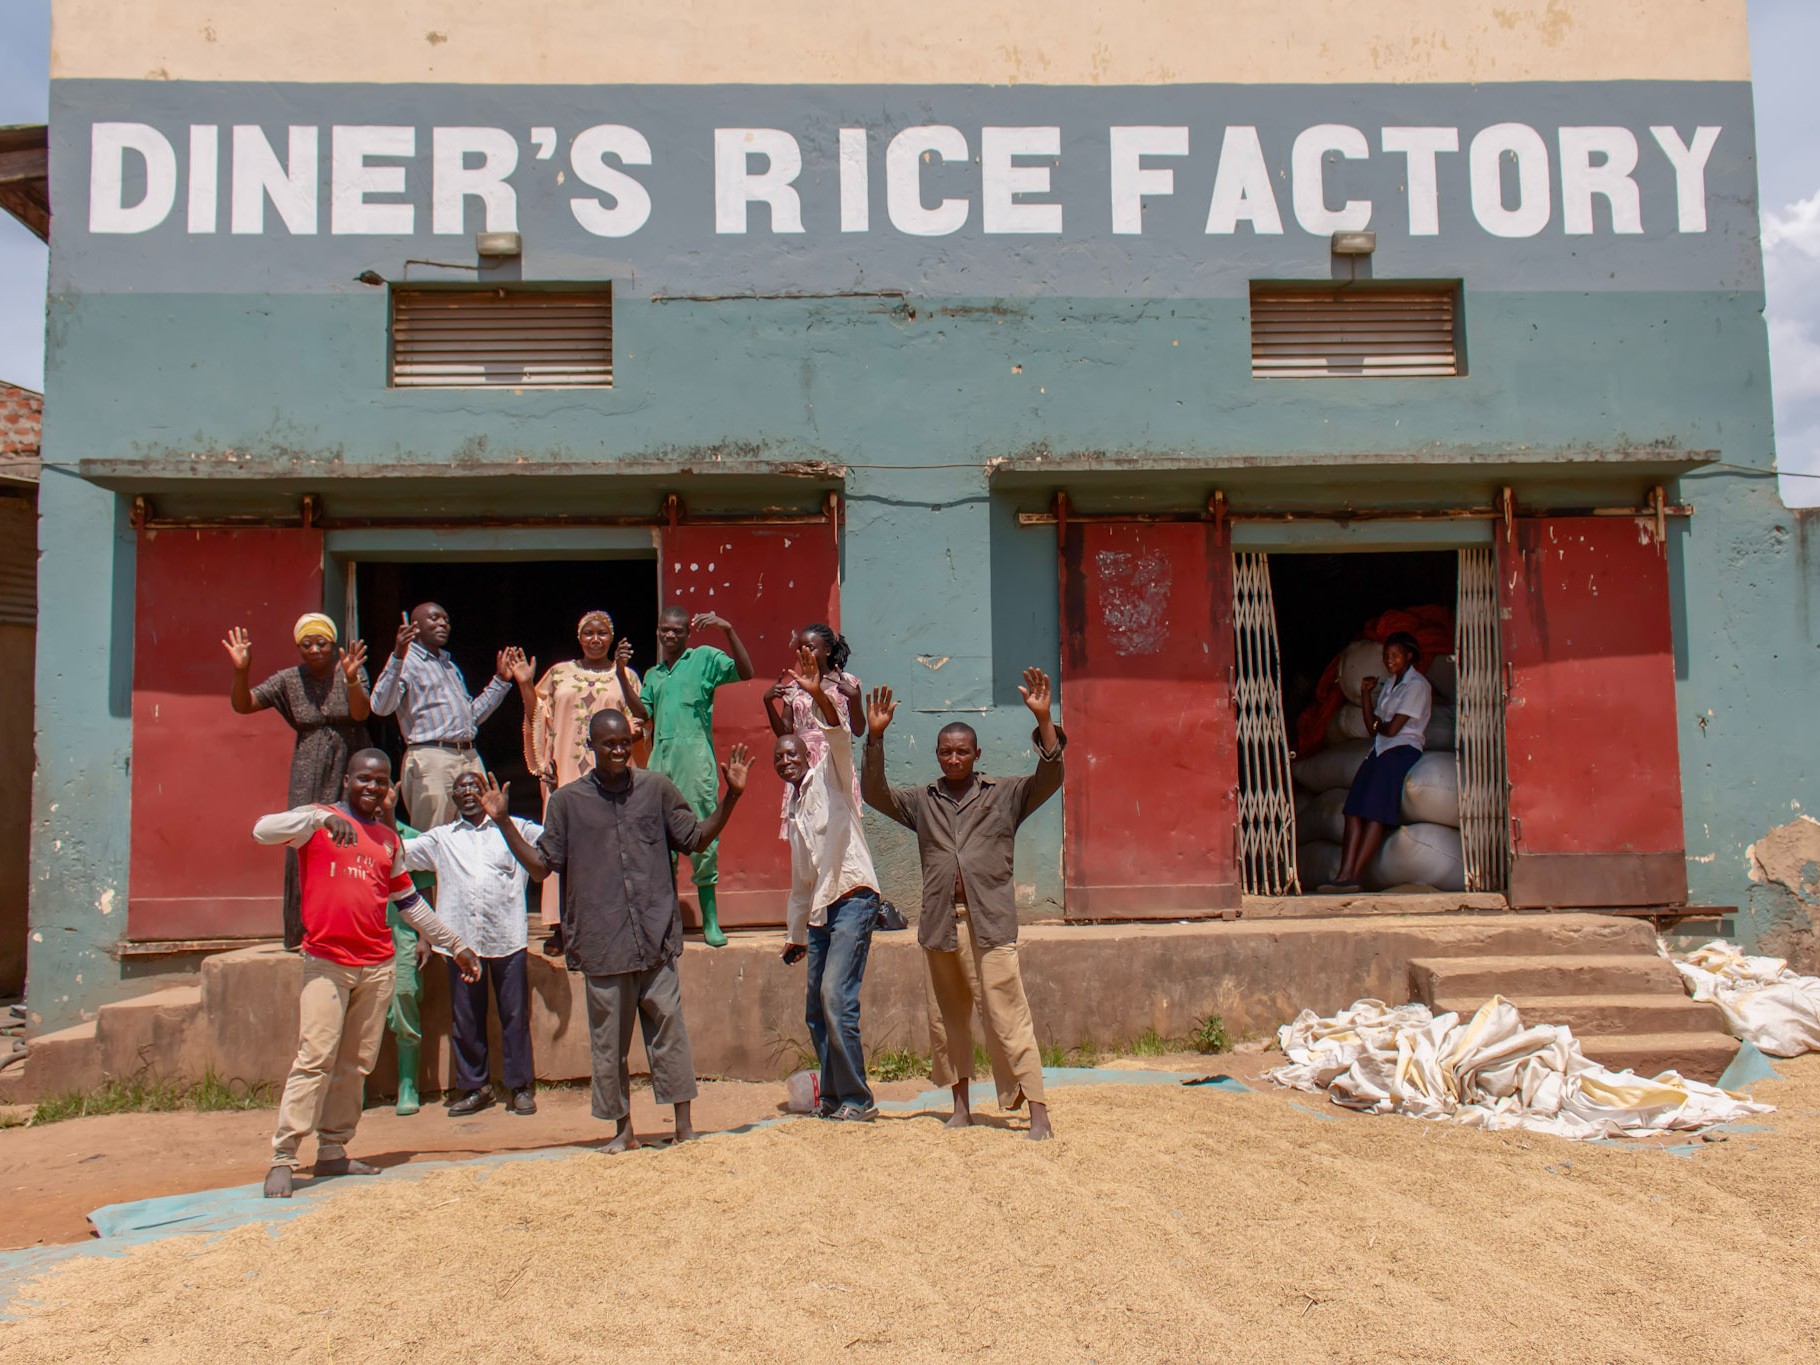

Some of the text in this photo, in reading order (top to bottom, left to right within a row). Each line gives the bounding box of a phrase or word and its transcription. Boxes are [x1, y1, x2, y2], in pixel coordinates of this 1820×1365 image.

[89, 122, 1722, 237] DINER'S RICE FACTORY
